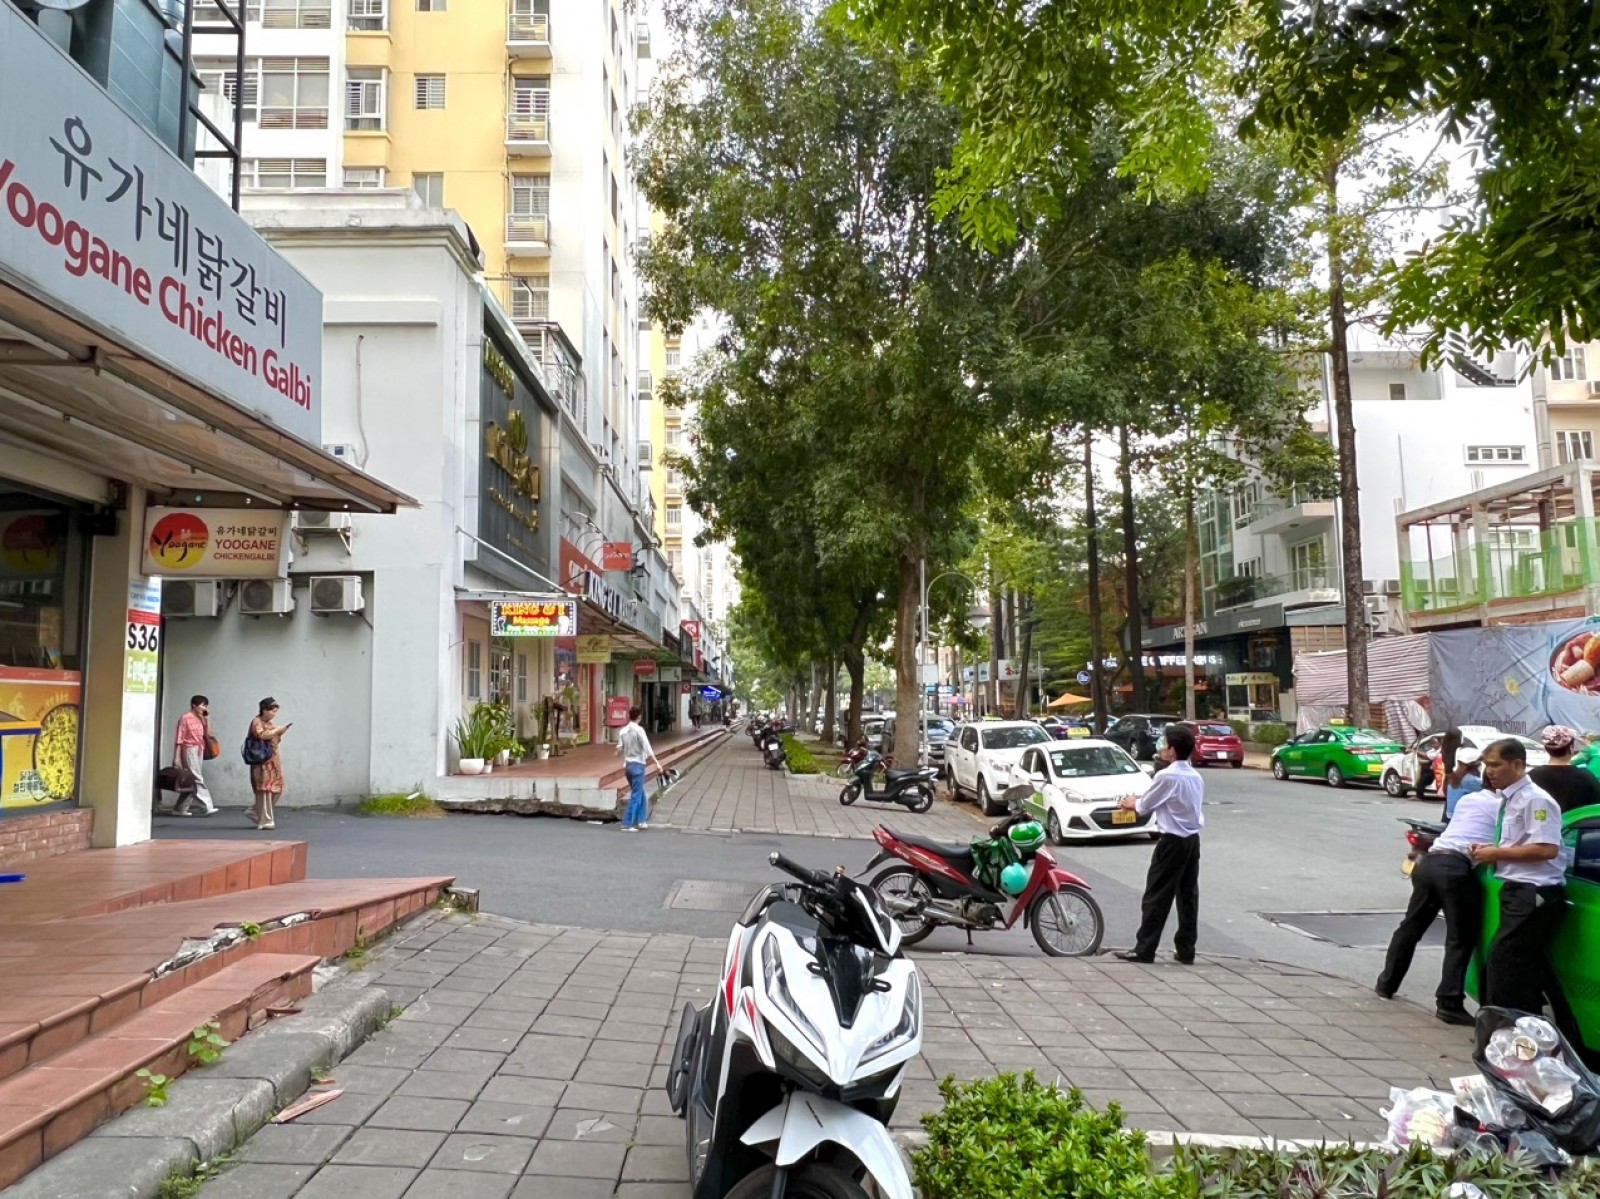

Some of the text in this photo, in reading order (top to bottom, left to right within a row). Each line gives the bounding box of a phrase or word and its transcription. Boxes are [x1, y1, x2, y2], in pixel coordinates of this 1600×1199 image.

[158, 276, 257, 376] Chicken
[262, 348, 311, 411] Galbi
[215, 539, 276, 550] YOOGANE
[501, 603, 540, 616] KING
[512, 616, 550, 627] Massage
[128, 622, 158, 652] S36
